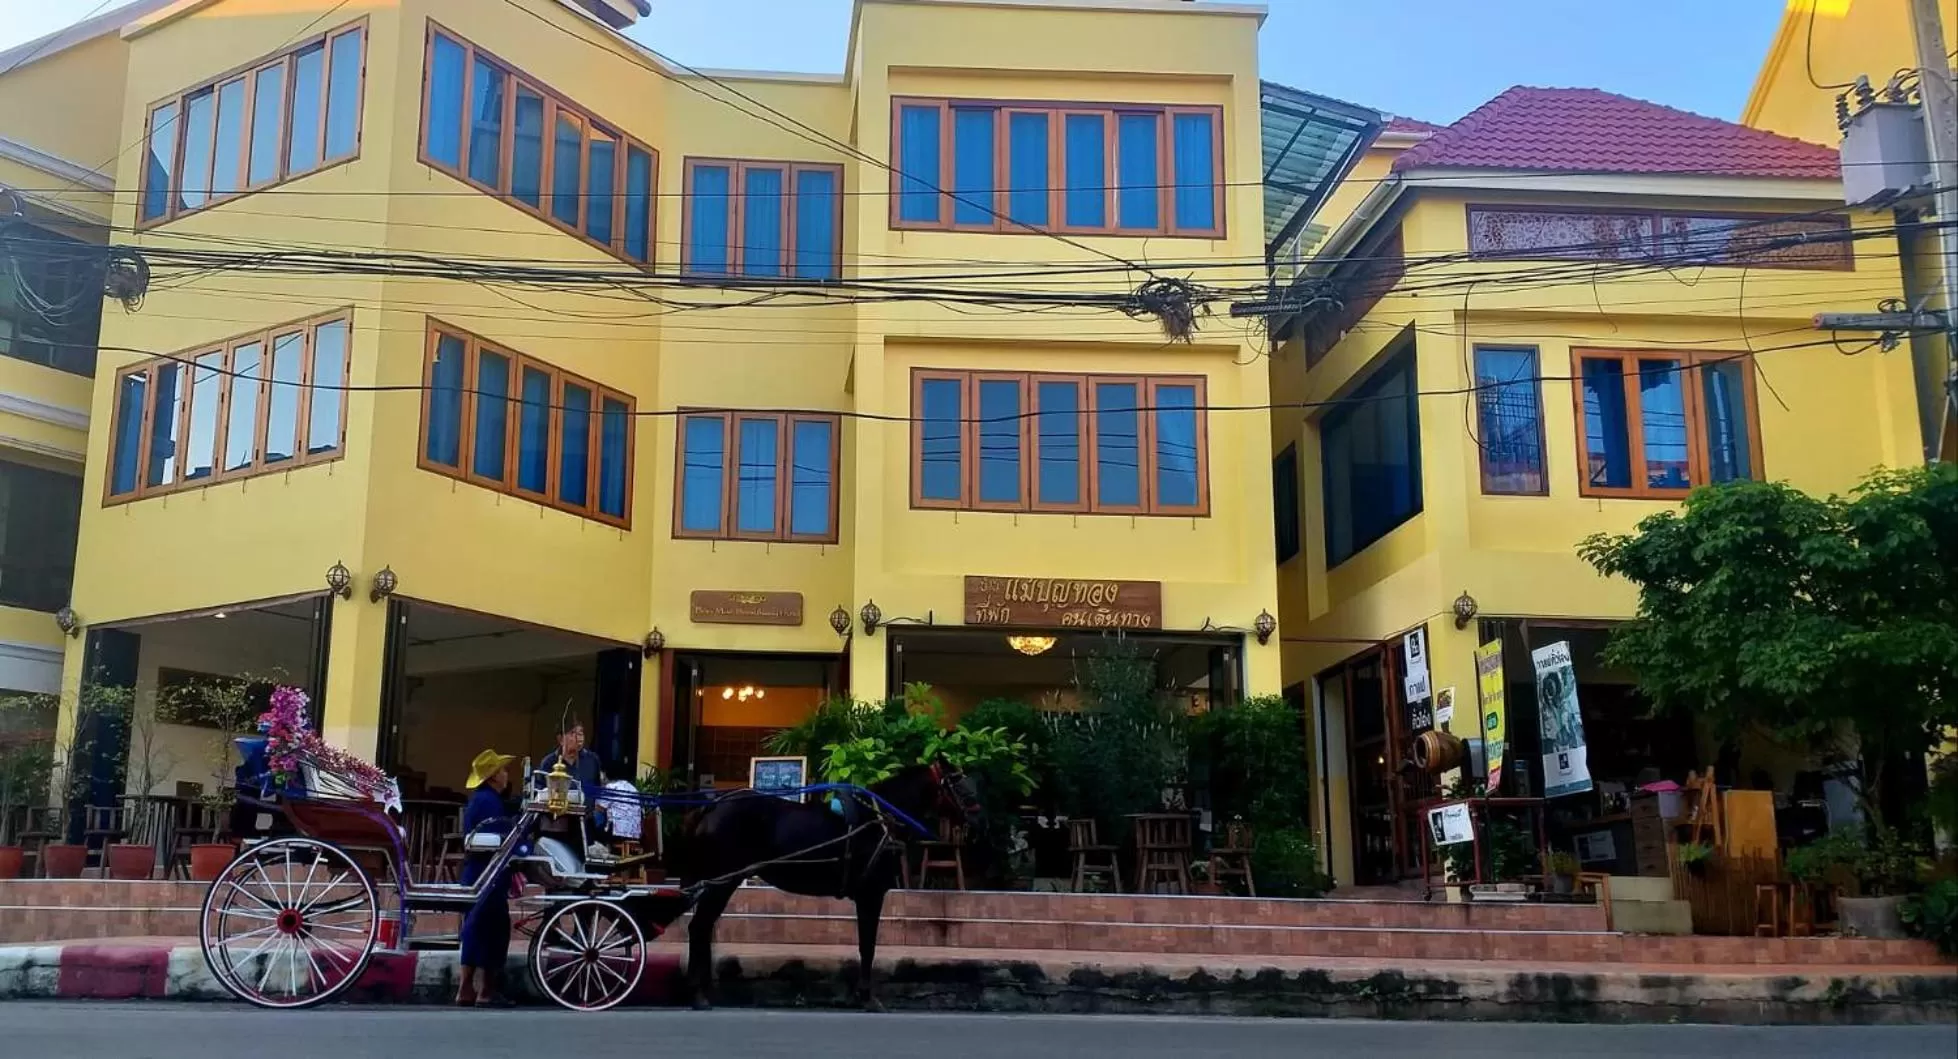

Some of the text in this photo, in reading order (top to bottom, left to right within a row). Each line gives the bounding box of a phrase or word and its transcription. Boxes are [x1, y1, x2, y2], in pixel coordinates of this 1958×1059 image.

[975, 594, 1152, 628] ที่พัก คนเดินทาง
